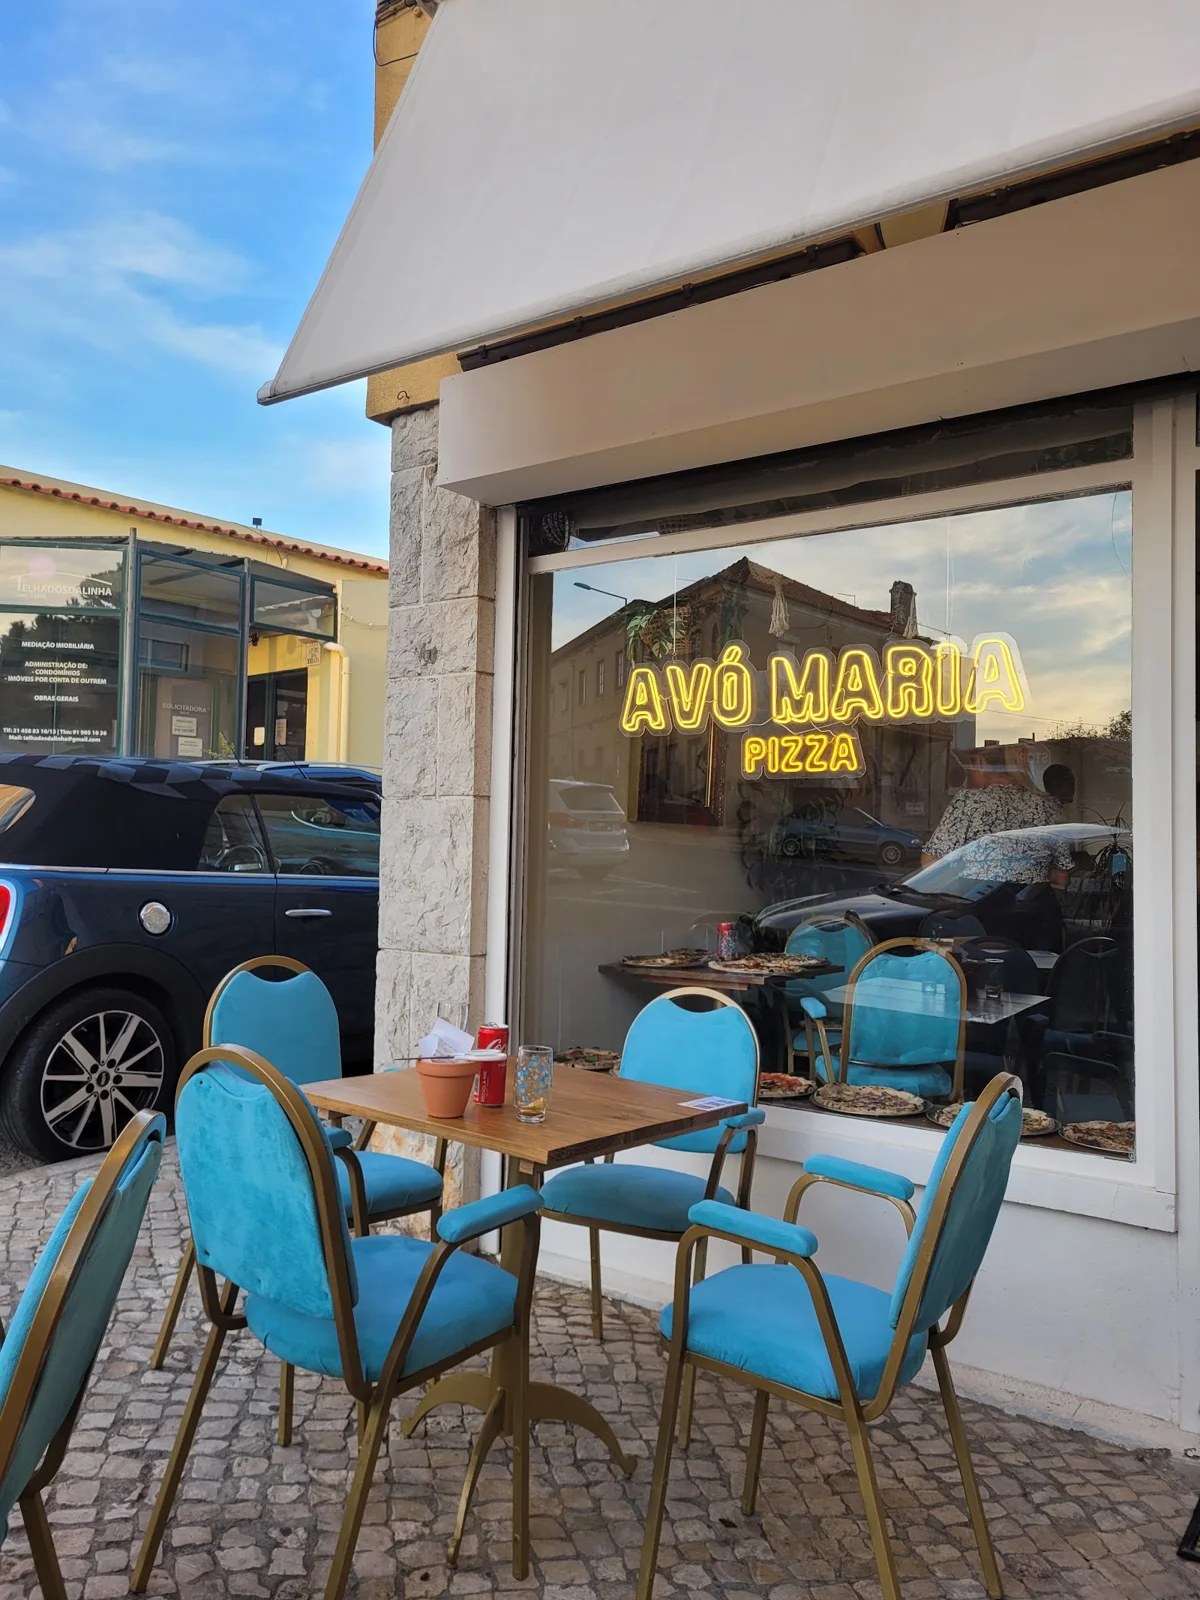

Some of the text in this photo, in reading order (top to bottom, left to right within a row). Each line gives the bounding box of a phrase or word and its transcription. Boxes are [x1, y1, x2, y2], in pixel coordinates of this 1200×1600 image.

[21, 641, 95, 650] MEDIAÇÃO IMOBILIÁRIA
[24, 661, 77, 669] ADMINISTRAÇÃO
[622, 638, 1026, 732] AVÓ MARIA
[743, 732, 859, 774] PIZZA
